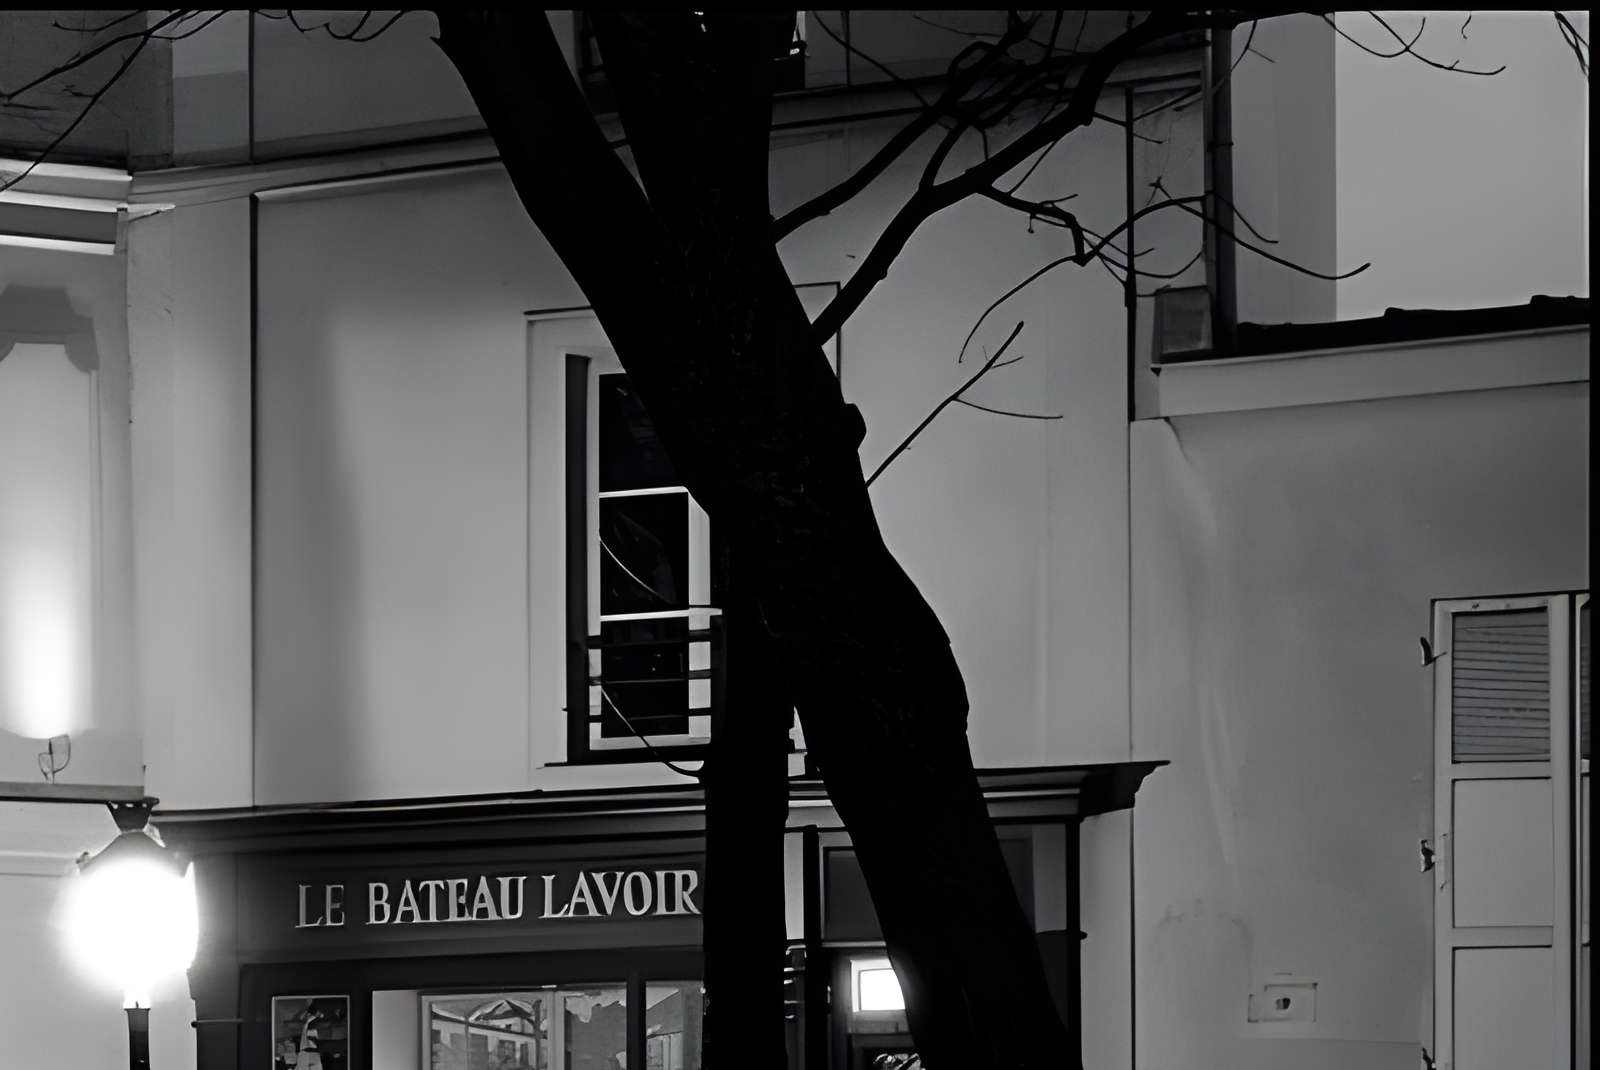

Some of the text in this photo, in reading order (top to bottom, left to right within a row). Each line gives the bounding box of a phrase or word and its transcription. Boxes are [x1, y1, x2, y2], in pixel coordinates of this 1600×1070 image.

[295, 869, 702, 929] LE BATEAU LAVOIR
